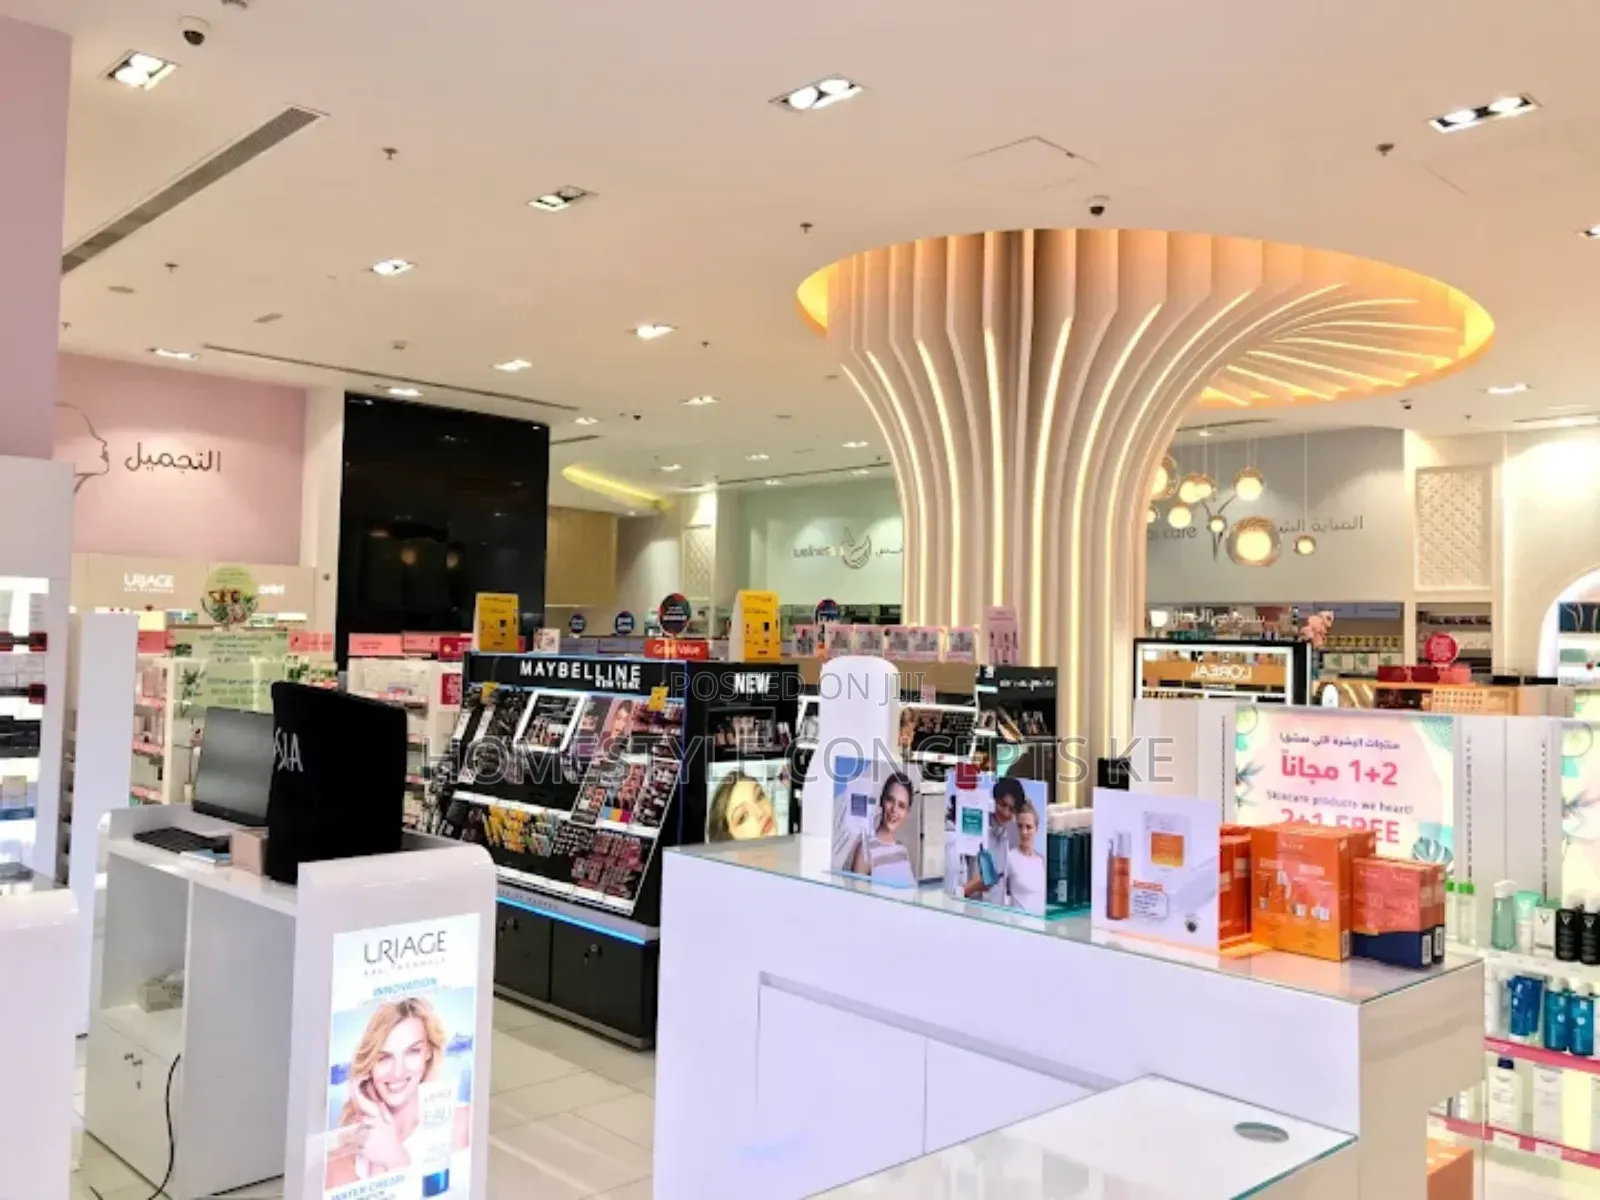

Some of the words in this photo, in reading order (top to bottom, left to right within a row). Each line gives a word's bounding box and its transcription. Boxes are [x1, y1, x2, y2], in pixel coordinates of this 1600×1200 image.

[124, 441, 221, 474] التجميل
[520, 659, 641, 682] MAYBELLINE
[733, 673, 771, 694] NEW
[1281, 749, 1340, 786] مجاناً
[1266, 789, 1309, 803] Skincare
[1312, 796, 1358, 810] products
[1361, 802, 1376, 810] we
[1335, 815, 1401, 844] FREE
[364, 930, 448, 964] URIAGE
[373, 976, 438, 997] INNOVATION
